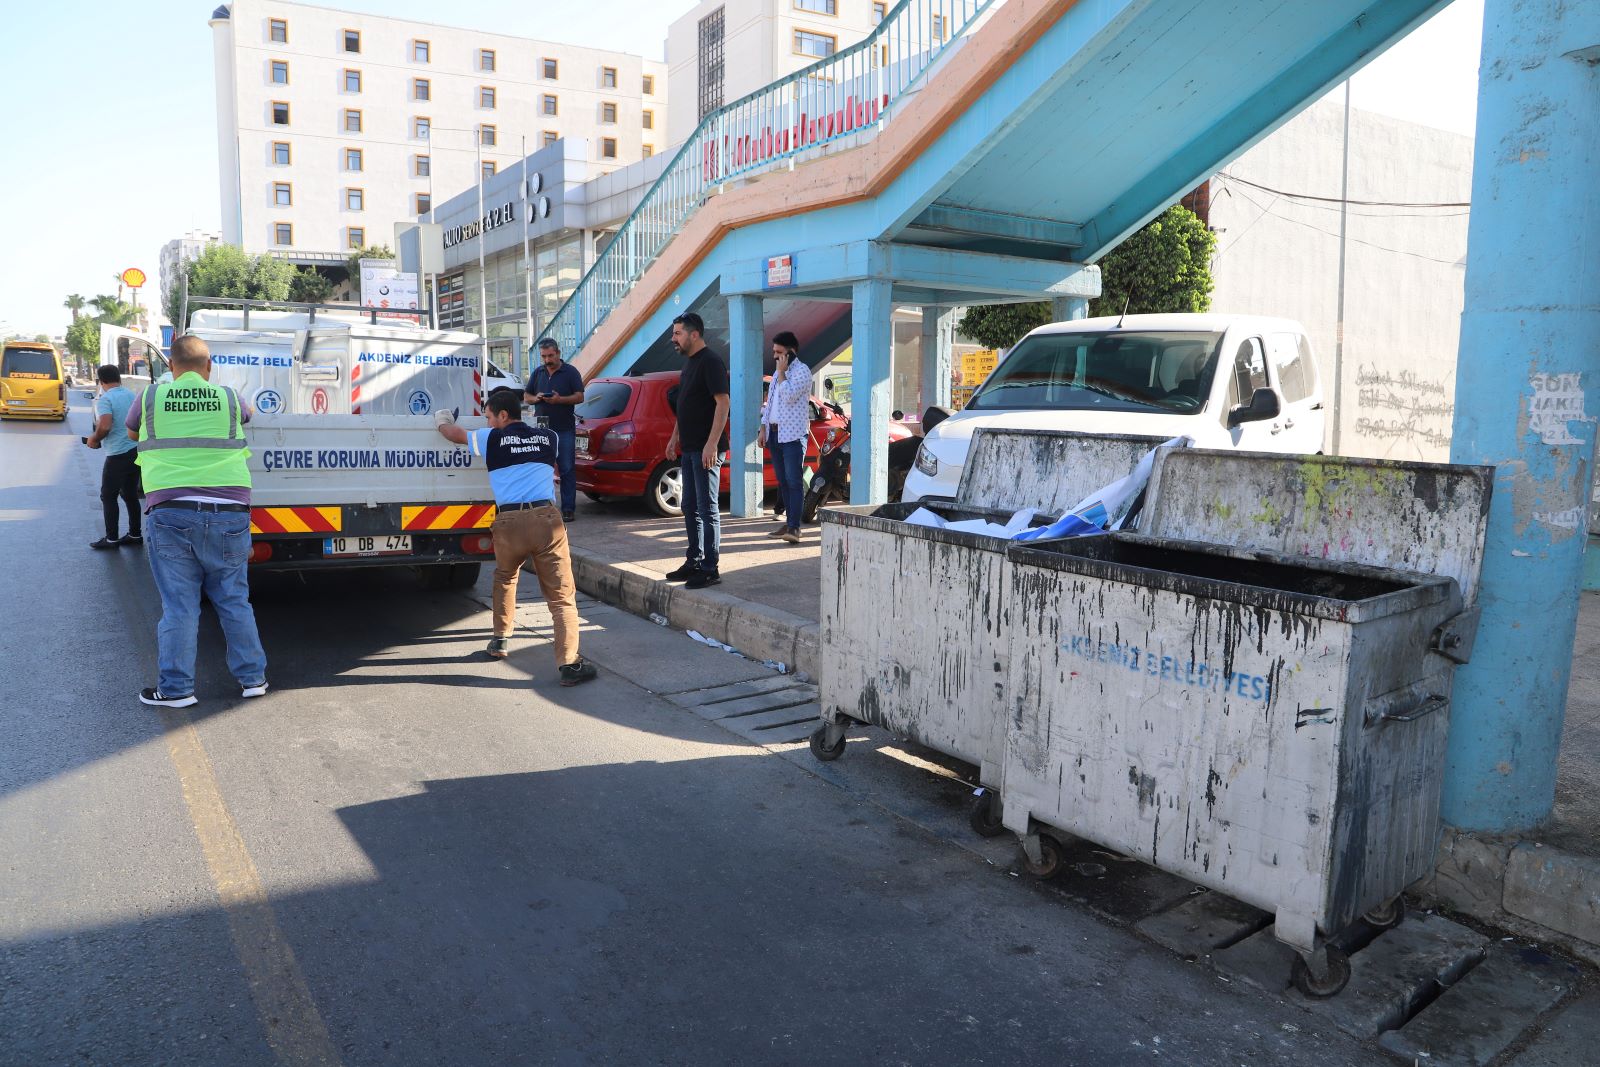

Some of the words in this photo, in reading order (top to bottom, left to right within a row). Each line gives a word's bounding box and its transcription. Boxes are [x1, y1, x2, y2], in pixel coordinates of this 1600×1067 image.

[443, 225, 462, 249] AUTO
[503, 202, 514, 223] EL
[210, 354, 259, 366] KDENİZ
[358, 351, 411, 365] AKDENİZ
[414, 353, 479, 368] BELEDİYESİ
[166, 385, 219, 399] AKDENİZ
[164, 398, 221, 412] BELEDİYESİ
[500, 435, 521, 447] AKDENİZ
[510, 444, 540, 454] MERSİN
[263, 450, 312, 472] ÇEVRE
[318, 450, 380, 468] KORUMA
[384, 447, 472, 468] MÜDÜRLÜĞÜ
[333, 538, 346, 552] 10
[358, 537, 374, 551] DB
[386, 535, 409, 550] 474
